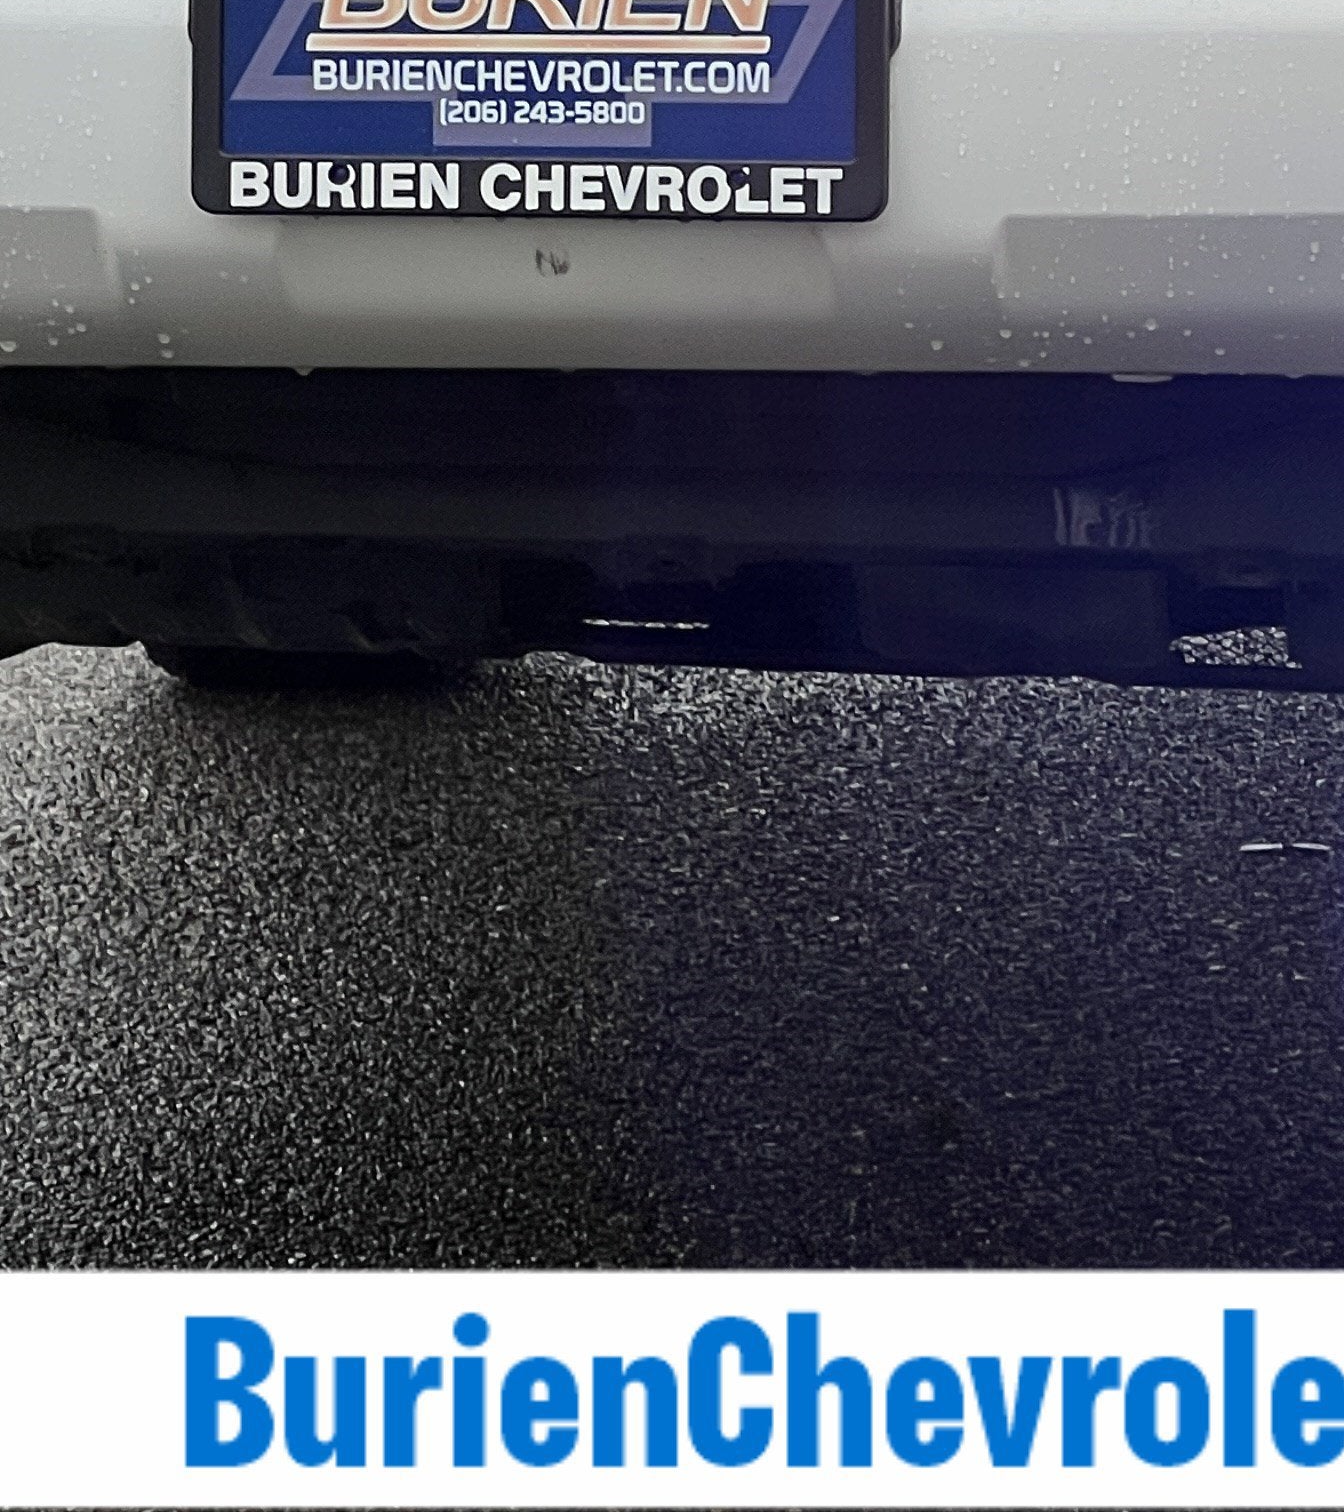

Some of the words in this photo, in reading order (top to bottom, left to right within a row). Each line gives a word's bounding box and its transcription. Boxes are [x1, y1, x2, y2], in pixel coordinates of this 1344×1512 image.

[312, 59, 770, 94] BURIENCHEVROLET.COM
[439, 99, 508, 125] (206)
[514, 99, 645, 125] 243-5800
[230, 161, 460, 210] BURIEN
[479, 162, 844, 215] CHEVROLET
